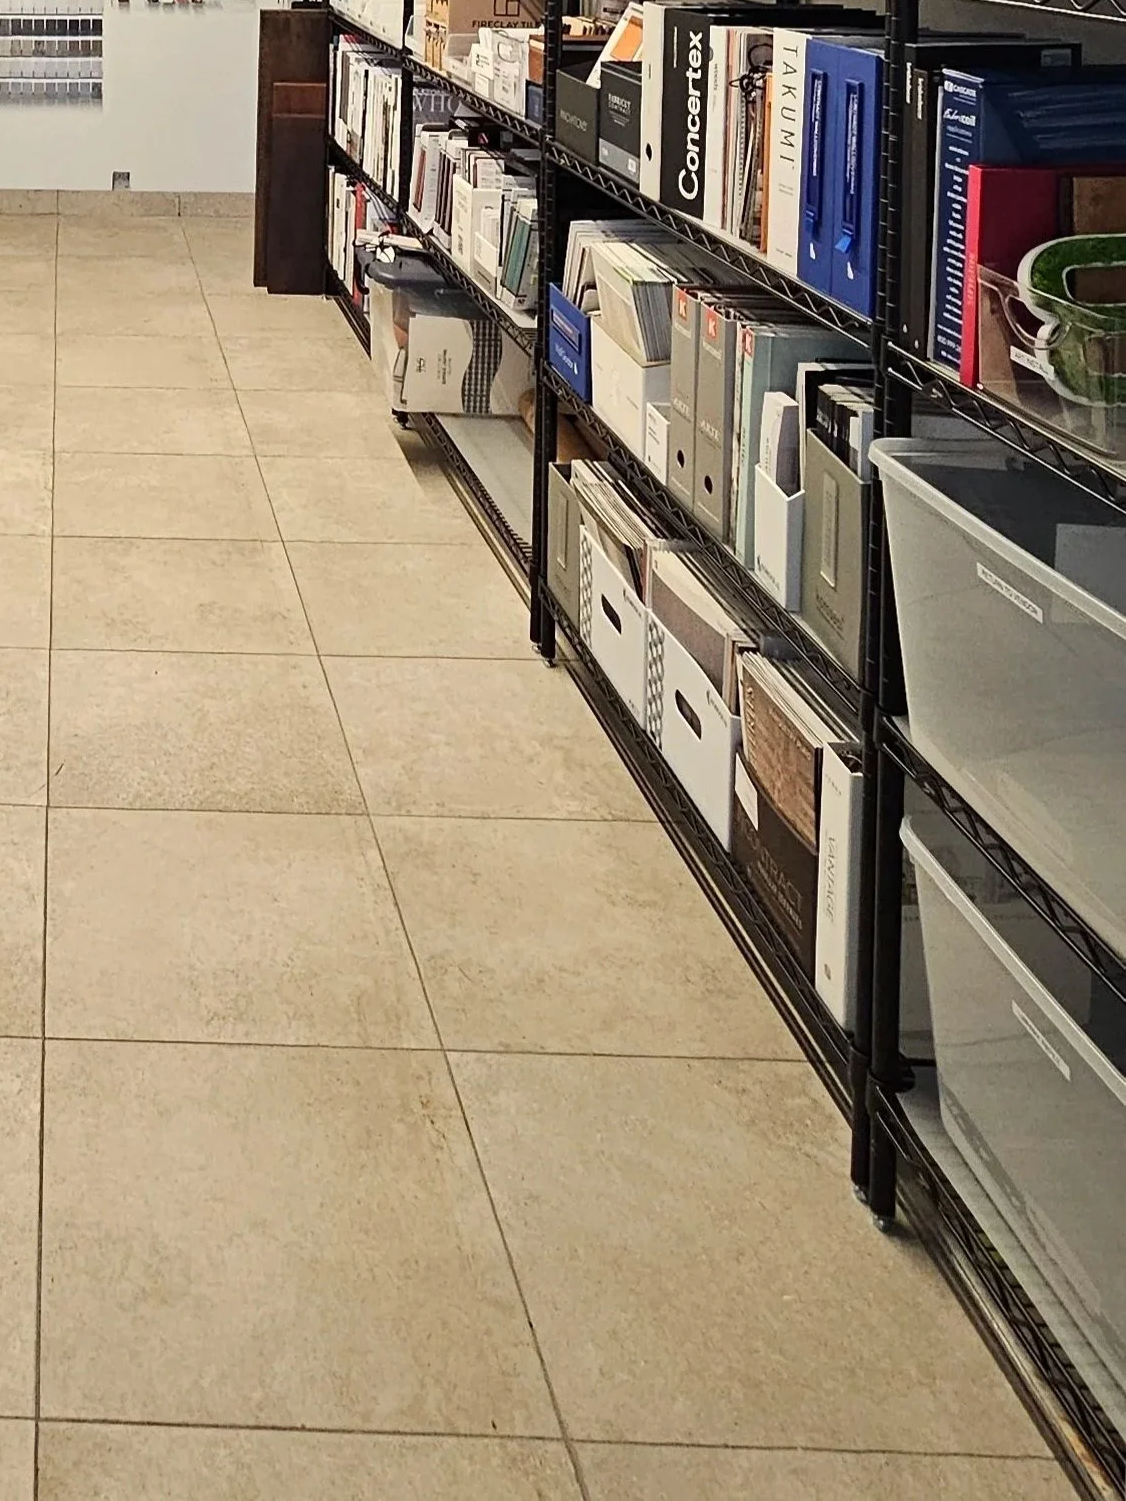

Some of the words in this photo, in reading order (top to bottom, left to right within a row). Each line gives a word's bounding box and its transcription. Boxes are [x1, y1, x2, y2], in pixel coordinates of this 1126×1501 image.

[472, 20, 519, 29] FIRECLAY
[678, 30, 703, 200] Concertex
[780, 45, 798, 164] TAKUMI
[678, 298, 687, 318] K
[708, 317, 716, 339] K
[745, 333, 752, 355] K
